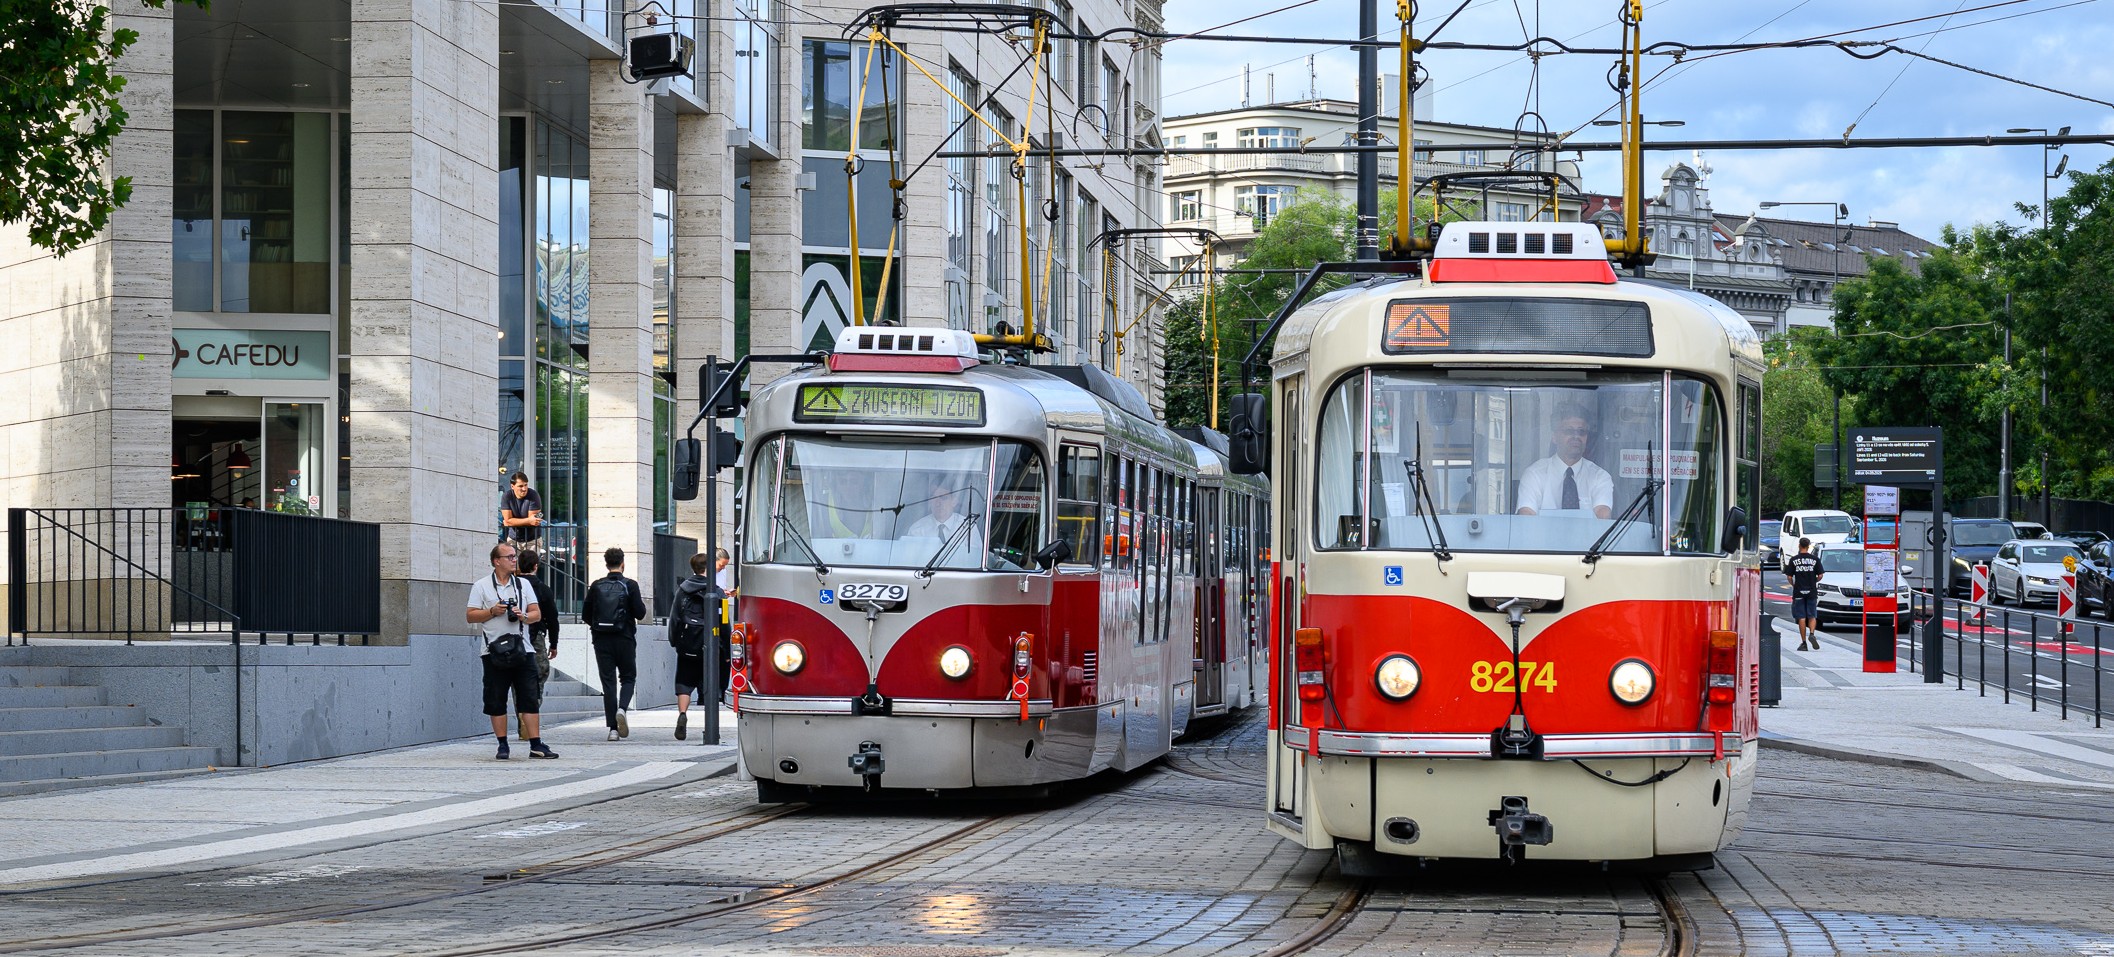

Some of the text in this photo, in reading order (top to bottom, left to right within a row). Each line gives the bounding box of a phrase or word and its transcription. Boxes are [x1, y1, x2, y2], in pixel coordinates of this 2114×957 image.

[197, 343, 299, 366] CAFEDU
[840, 584, 905, 600] 8279
[1470, 660, 1558, 693] 8274
